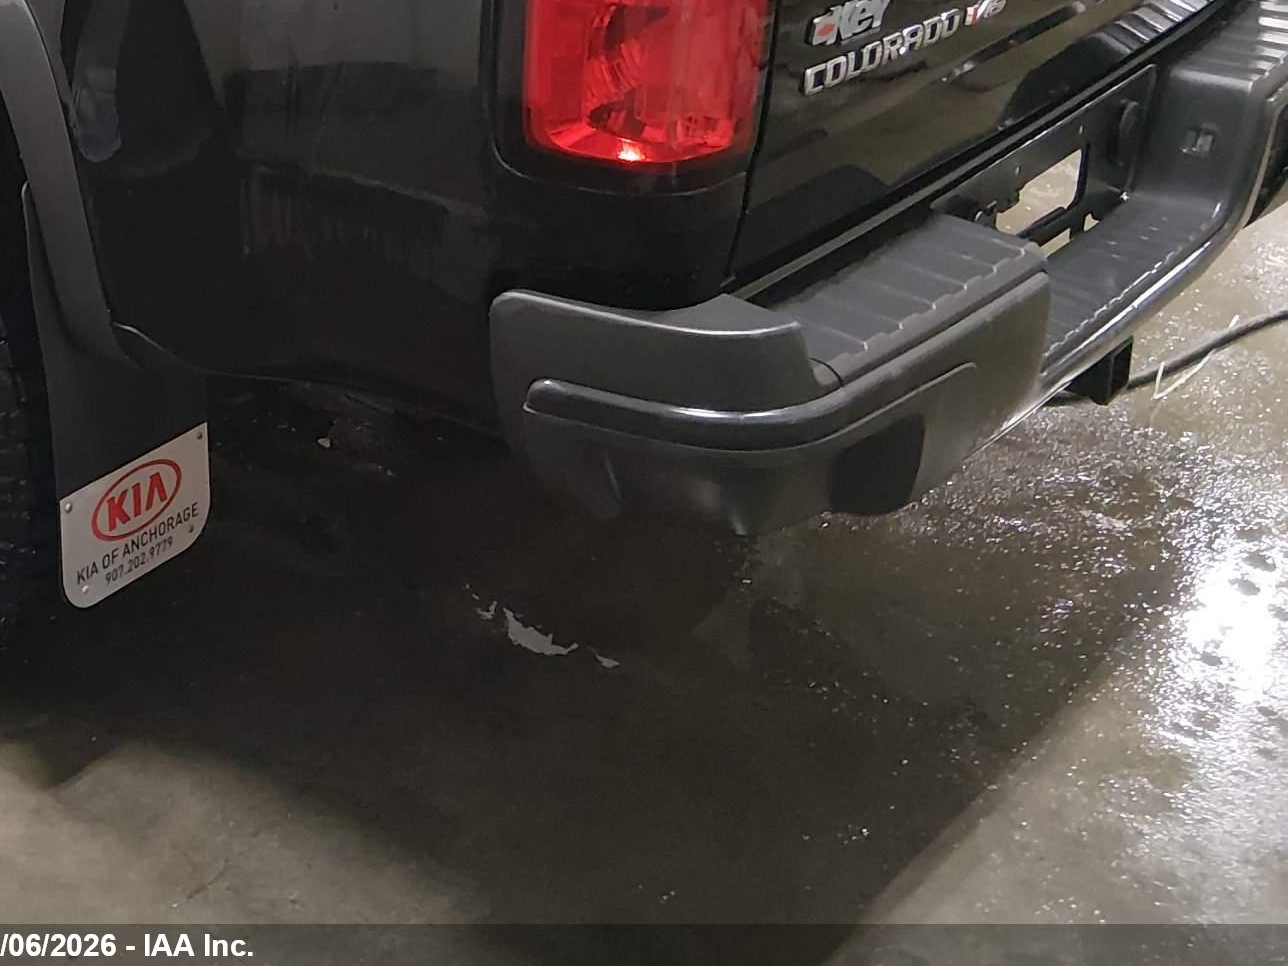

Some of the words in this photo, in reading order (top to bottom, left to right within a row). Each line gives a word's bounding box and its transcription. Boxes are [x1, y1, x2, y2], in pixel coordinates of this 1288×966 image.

[804, 8, 961, 95] COLORADO
[107, 472, 168, 532] KIA
[76, 562, 99, 586] KIA
[101, 548, 120, 570] OF
[122, 501, 200, 558] ANCHORAGE
[105, 536, 174, 586] 907.202.9779
